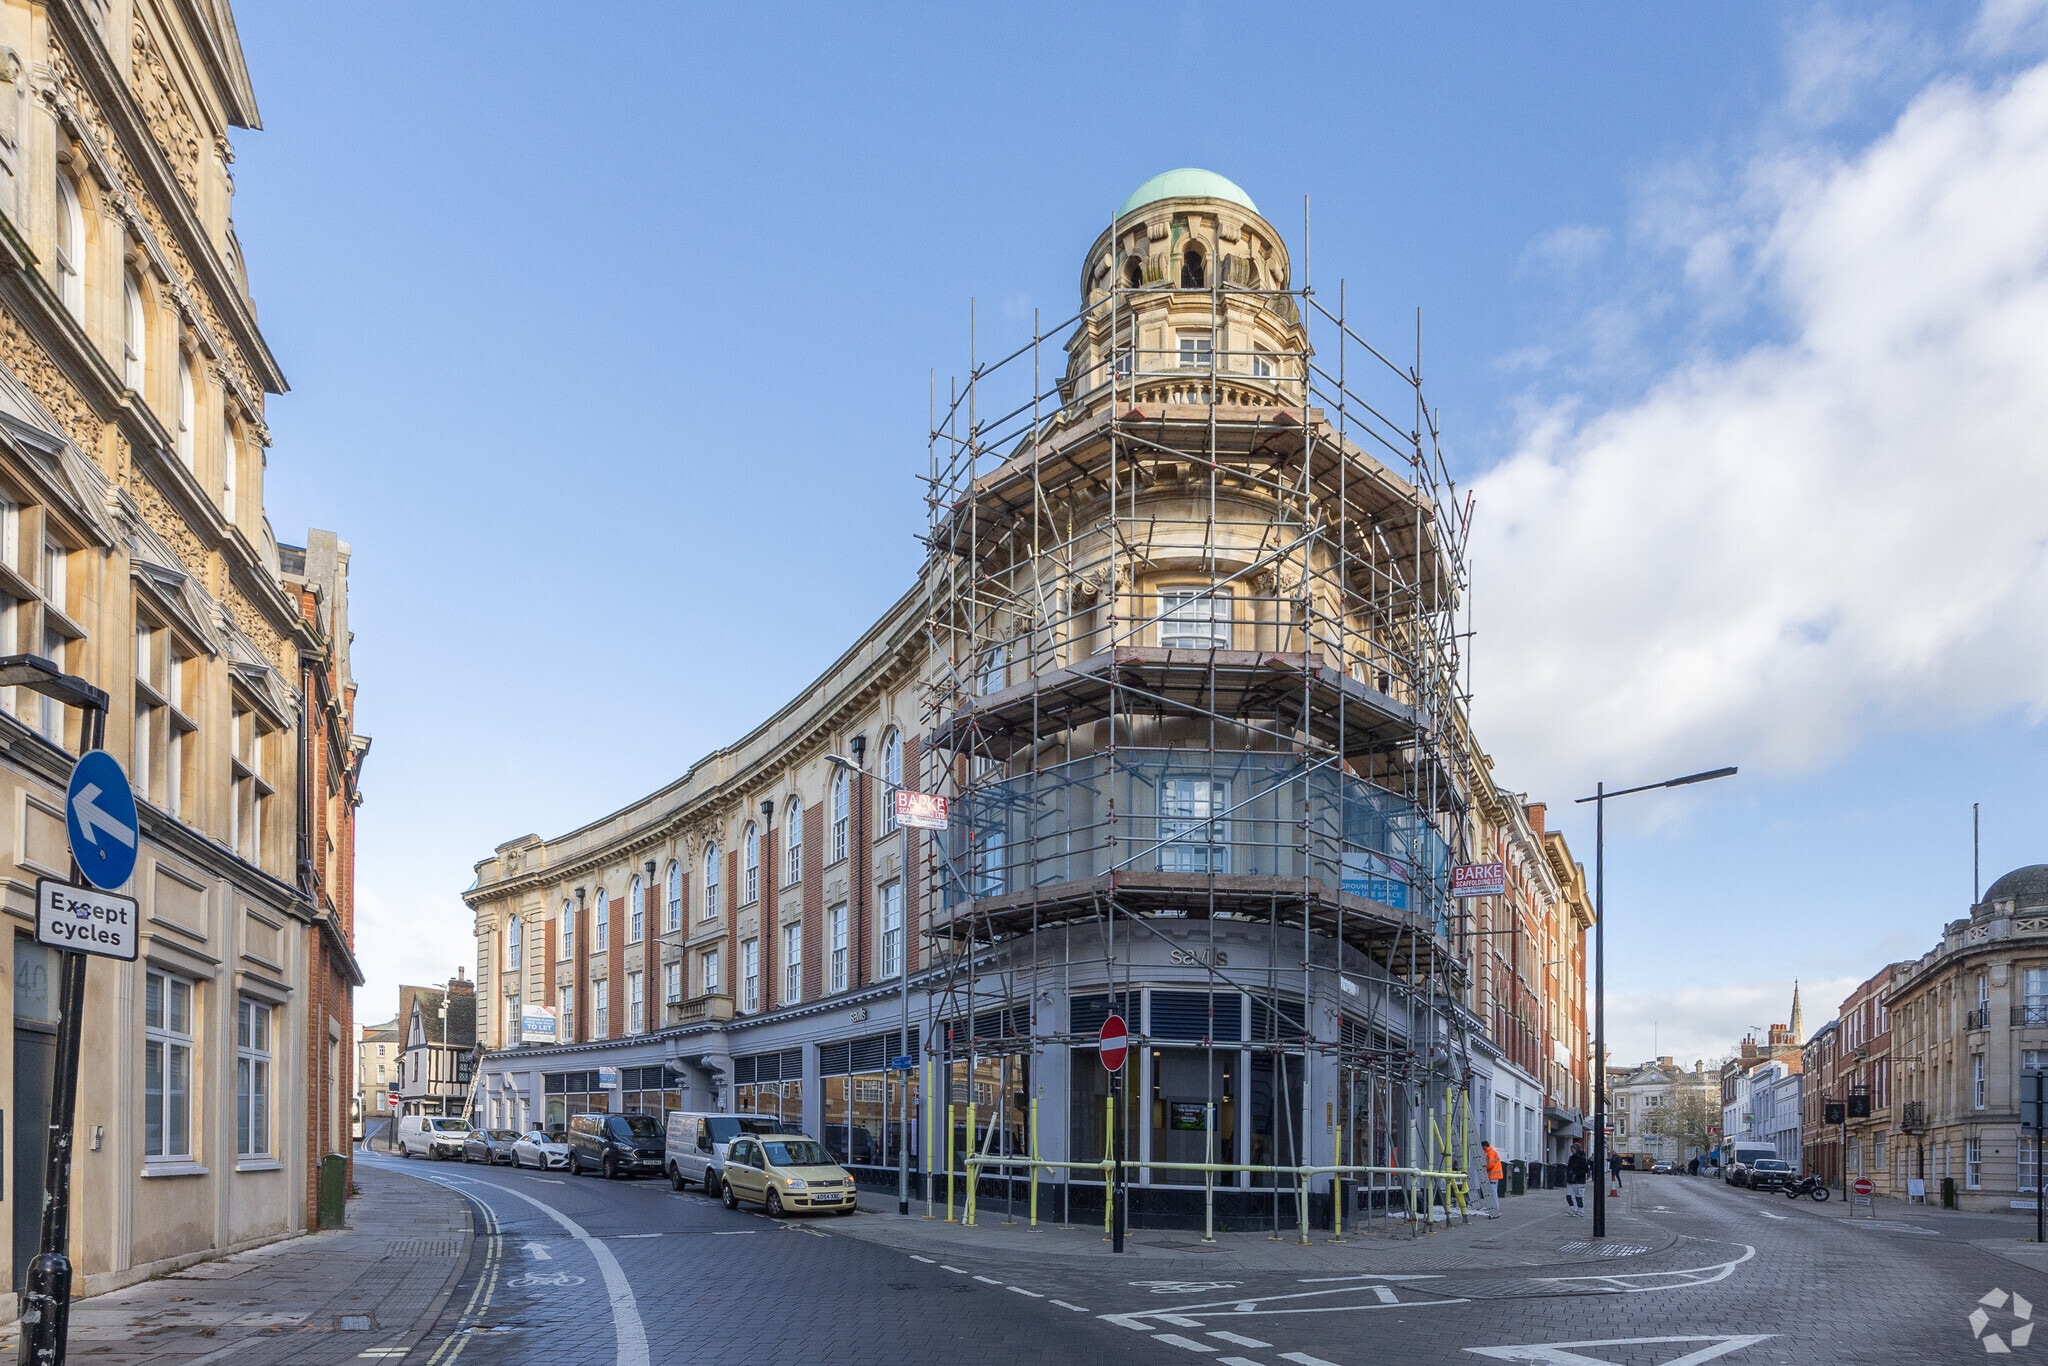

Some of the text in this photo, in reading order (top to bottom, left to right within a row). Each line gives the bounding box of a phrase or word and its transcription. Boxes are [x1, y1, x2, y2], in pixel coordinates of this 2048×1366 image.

[898, 793, 945, 813] BARKE
[1455, 865, 1501, 881] BARKE
[1455, 879, 1491, 888] SCAFFOLDING
[51, 920, 121, 946] cycles
[1171, 946, 1228, 966] savils
